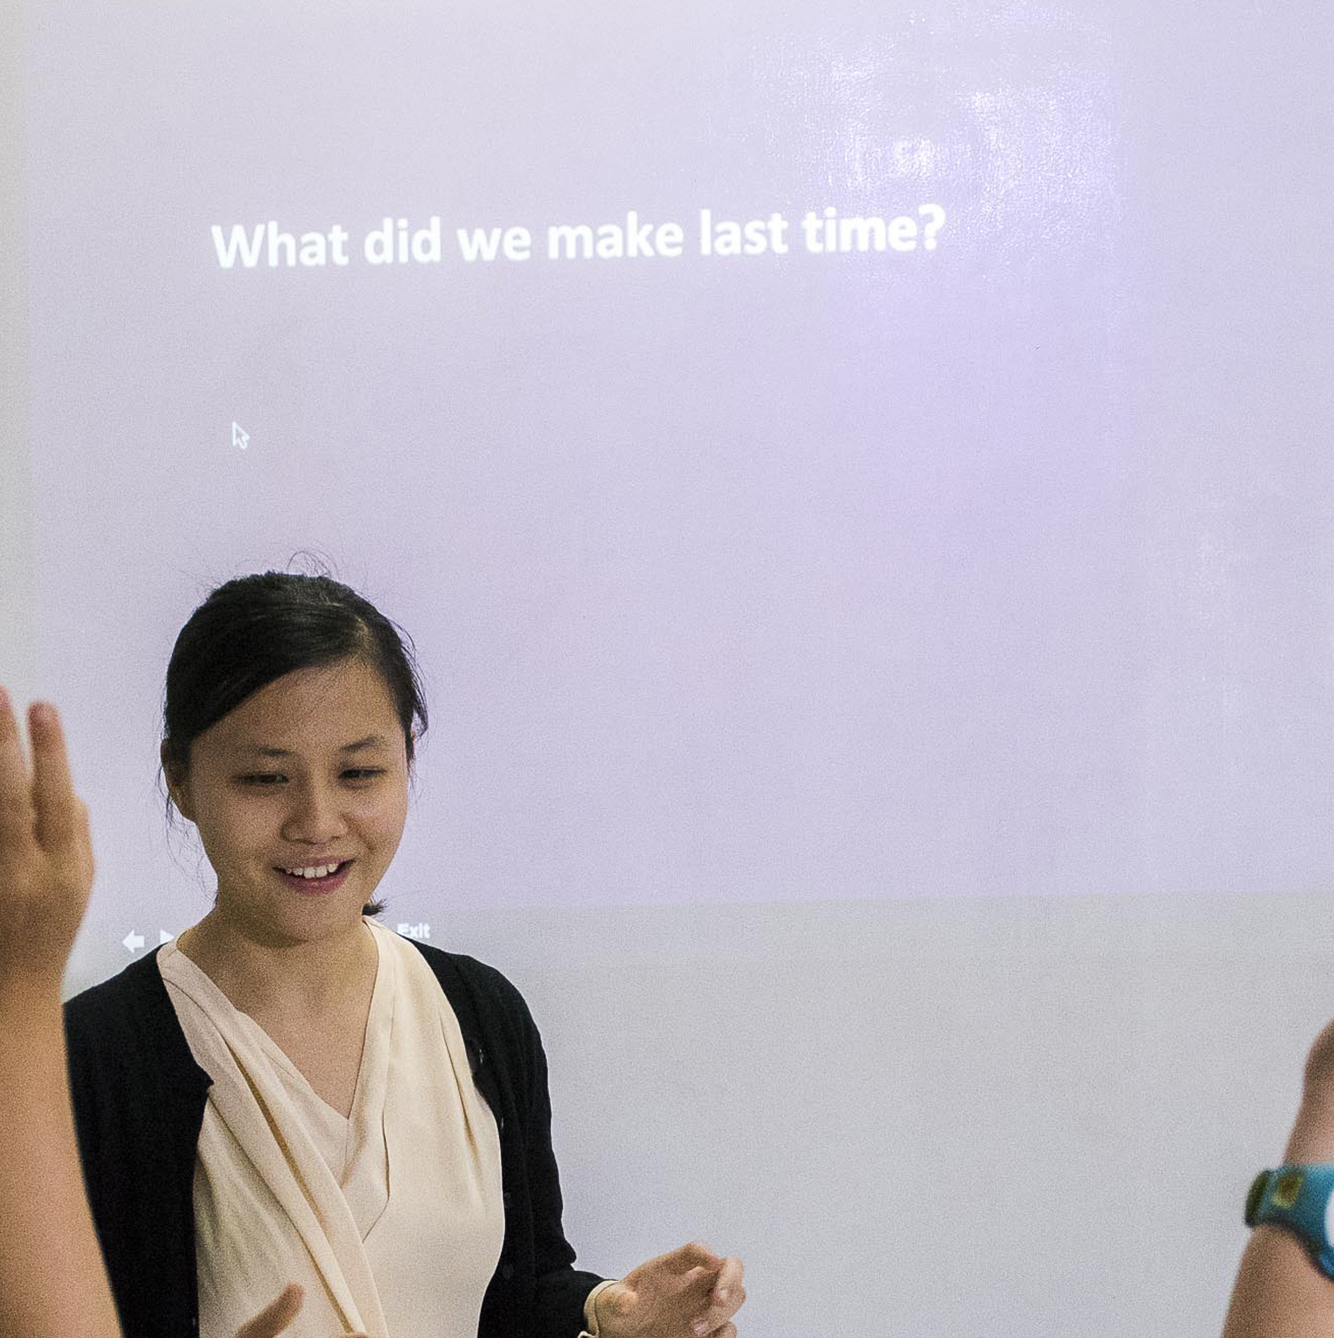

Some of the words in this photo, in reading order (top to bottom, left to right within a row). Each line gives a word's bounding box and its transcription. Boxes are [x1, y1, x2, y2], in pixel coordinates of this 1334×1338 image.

[210, 223, 350, 269] What
[363, 215, 442, 265] did
[455, 225, 533, 263] we
[546, 209, 685, 260] make
[698, 207, 790, 257] last
[801, 203, 948, 253] time?
[397, 922, 431, 939] Exit
